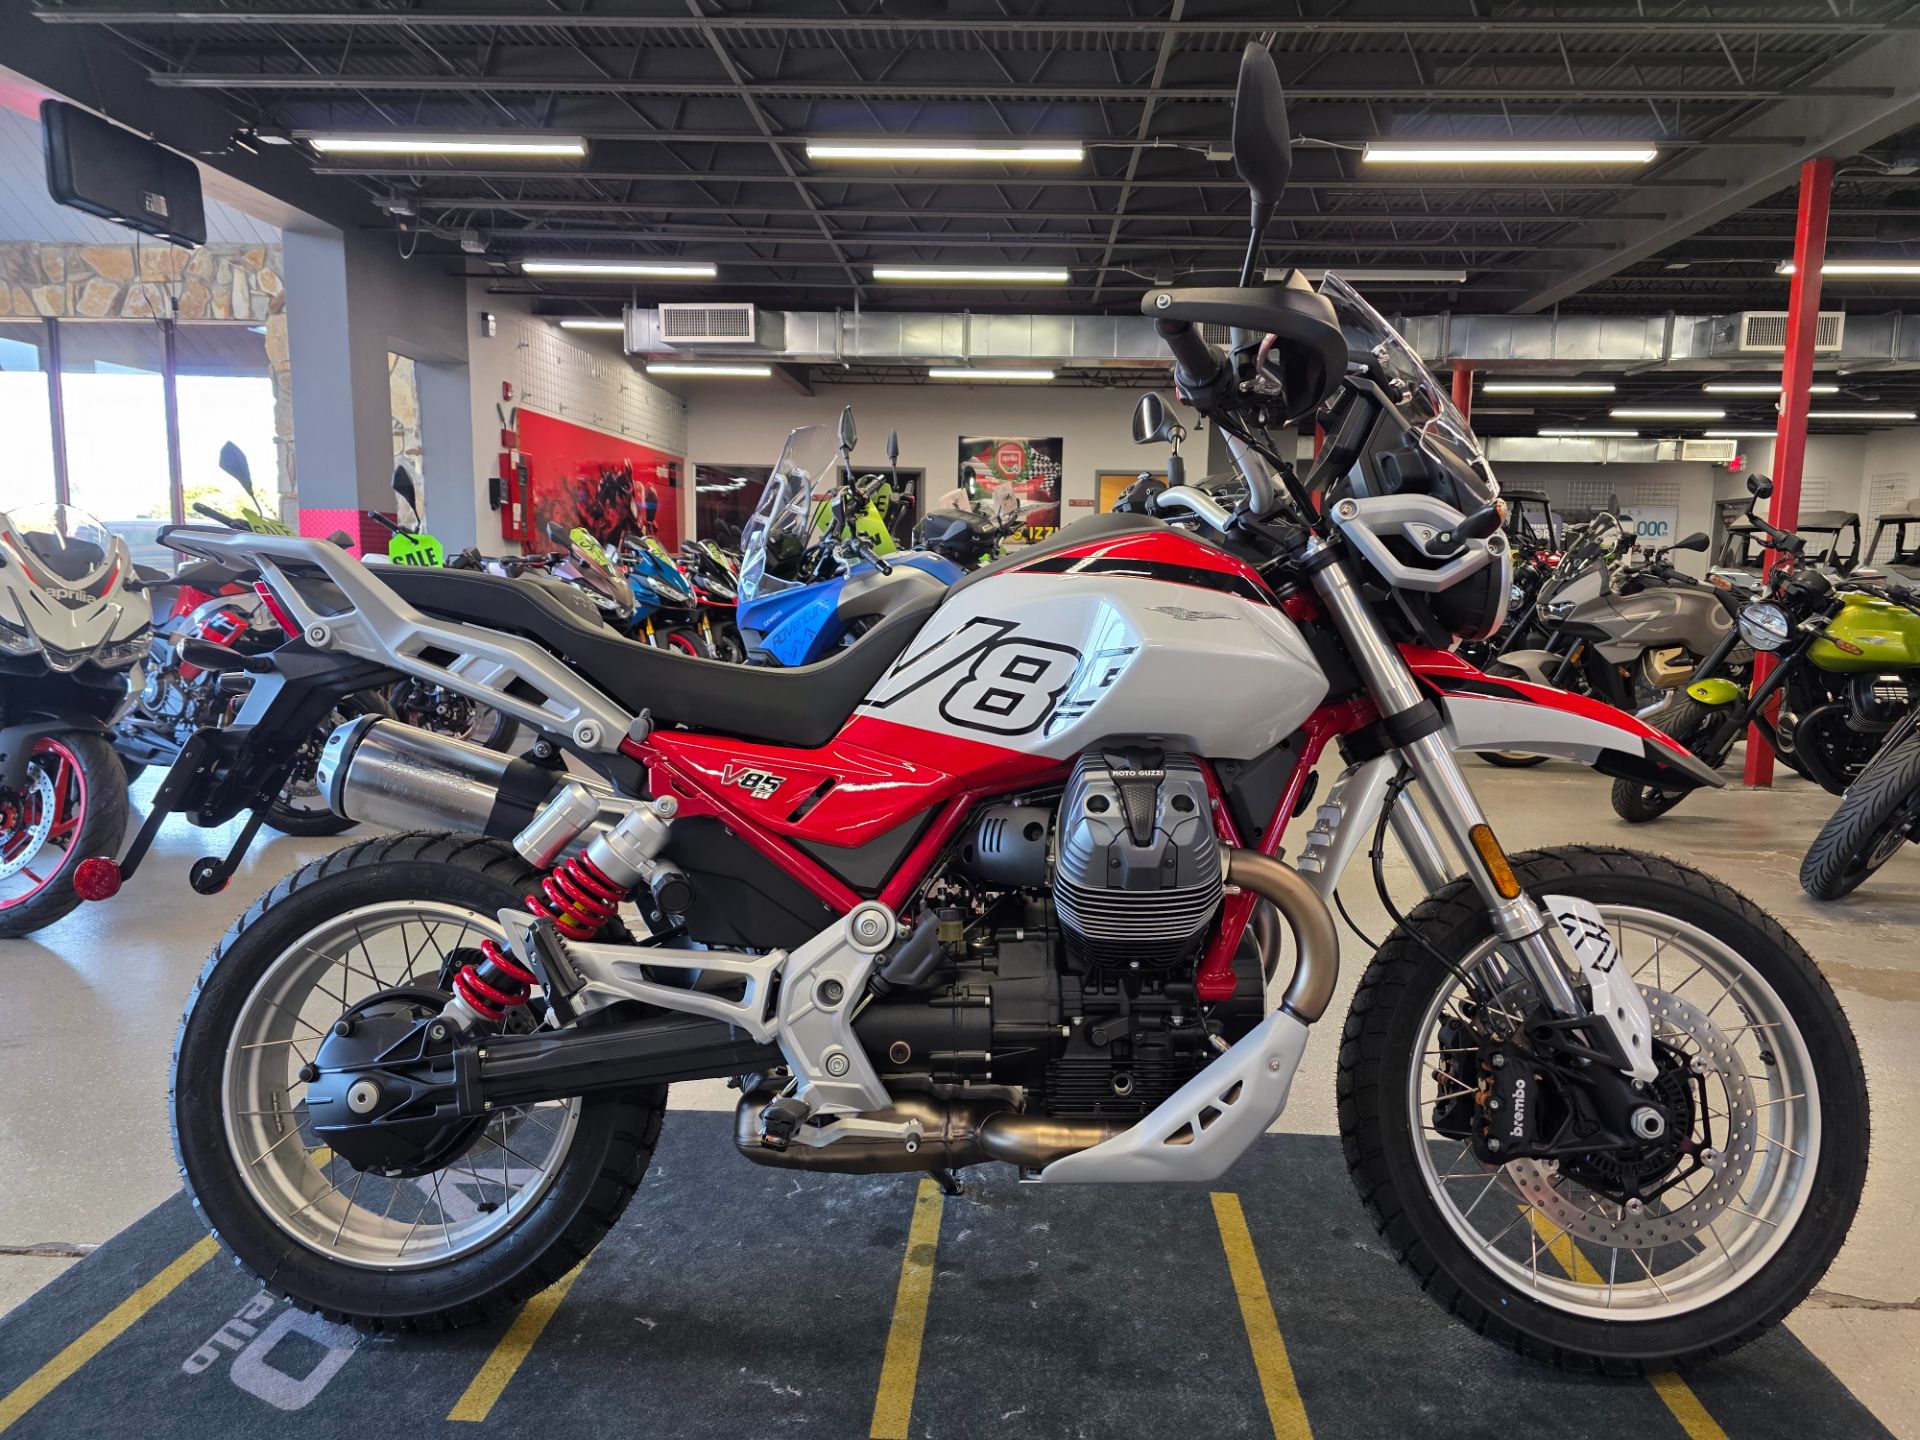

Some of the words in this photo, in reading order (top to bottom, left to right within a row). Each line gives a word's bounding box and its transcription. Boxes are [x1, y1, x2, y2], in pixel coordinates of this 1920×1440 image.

[45, 587, 97, 603] aprilia
[721, 763, 787, 795] V85
[1509, 1079, 1526, 1137] brembo
